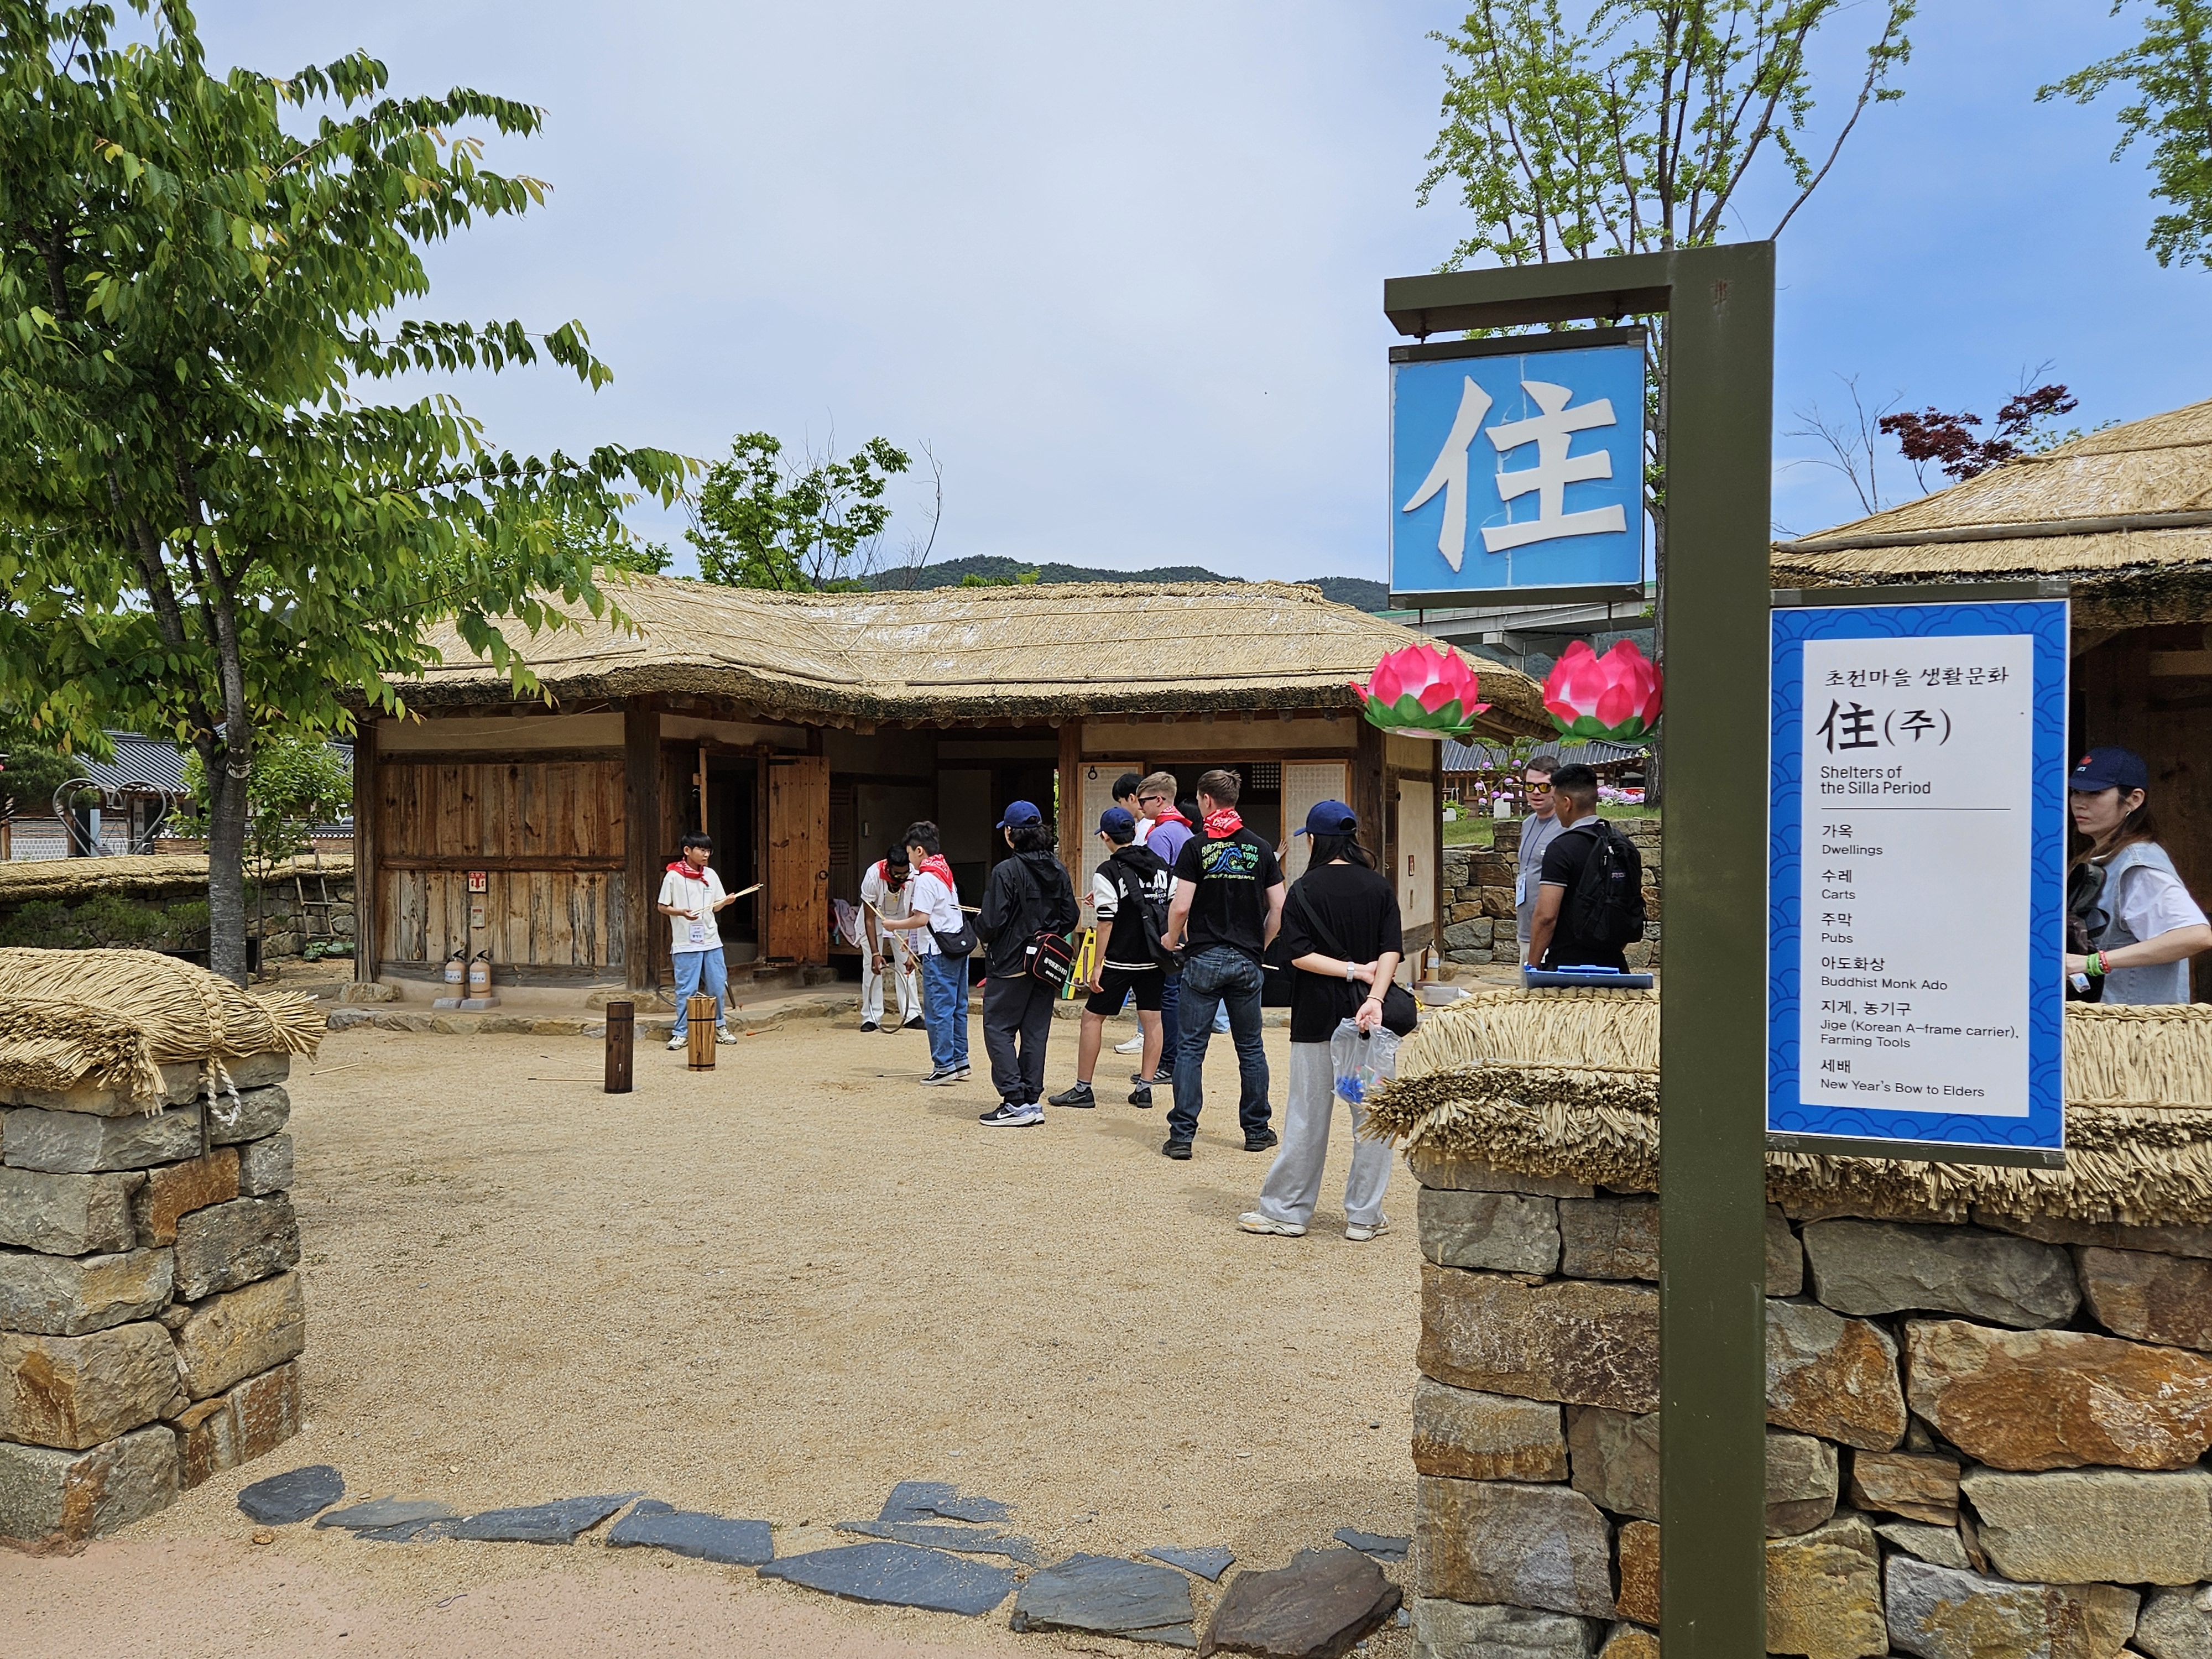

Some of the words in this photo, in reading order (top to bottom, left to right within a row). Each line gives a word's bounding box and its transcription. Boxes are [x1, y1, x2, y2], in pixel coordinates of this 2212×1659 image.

[1402, 375, 1627, 573] 住
[1825, 668, 1912, 688] 초전마을
[1919, 666, 2009, 686] 생활문화
[1815, 698, 1951, 755] 住(주)
[1820, 766, 1884, 779] Shelters
[1887, 765, 1902, 779] of
[1820, 781, 1845, 794] the
[1848, 781, 1879, 794] Silla
[1883, 781, 1931, 794] Period
[1822, 824, 1853, 838] 가옥
[1822, 844, 1883, 857] Dwellings
[1821, 869, 1852, 883] 수레
[1822, 889, 1856, 900] Carts
[1821, 912, 1853, 927] 주막
[1822, 932, 1854, 943] Pubs
[1822, 956, 1885, 972] 아도화상
[1822, 975, 1877, 988] Buddhist
[1882, 978, 1917, 989] Monk
[1921, 979, 1948, 990] Ado
[1821, 999, 1857, 1015] 지게,
[1863, 1001, 1912, 1016] 농기구
[1820, 1019, 1847, 1031] Jige
[1851, 1019, 1901, 1032] (Korean
[1966, 1025, 2018, 1039] carrier),
[1821, 1034, 1872, 1047] Farming
[1876, 1036, 1911, 1048] Tools
[1820, 1059, 1850, 1074] 세배
[1821, 1078, 1848, 1089] New
[1851, 1080, 1891, 1092] Year's
[1895, 1083, 1923, 1094] Bow
[1926, 1085, 1939, 1095] to
[1943, 1085, 1985, 1097] Elders
